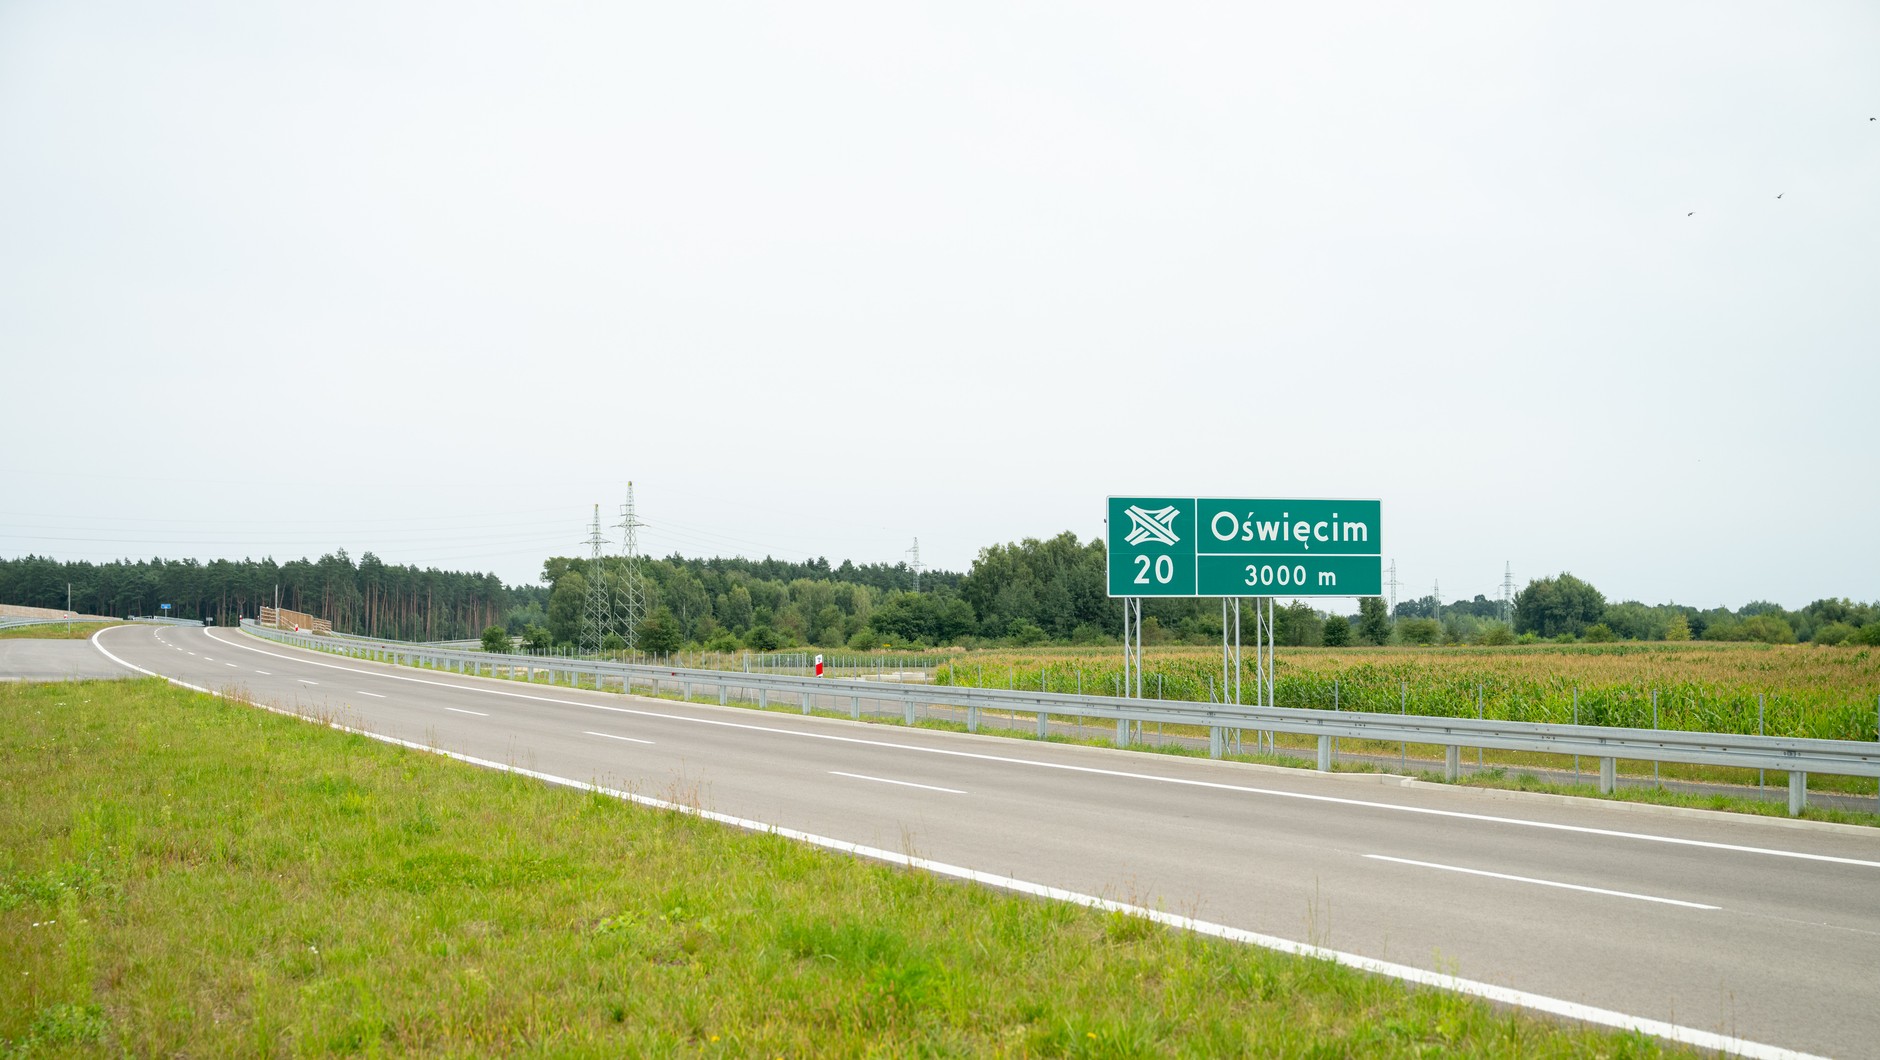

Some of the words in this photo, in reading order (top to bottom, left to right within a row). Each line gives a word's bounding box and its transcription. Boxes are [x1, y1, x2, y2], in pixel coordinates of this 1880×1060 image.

[1211, 510, 1368, 550] Oświęcim
[1133, 554, 1174, 584] 20
[1244, 564, 1307, 586] 3000
[1318, 571, 1336, 586] m
